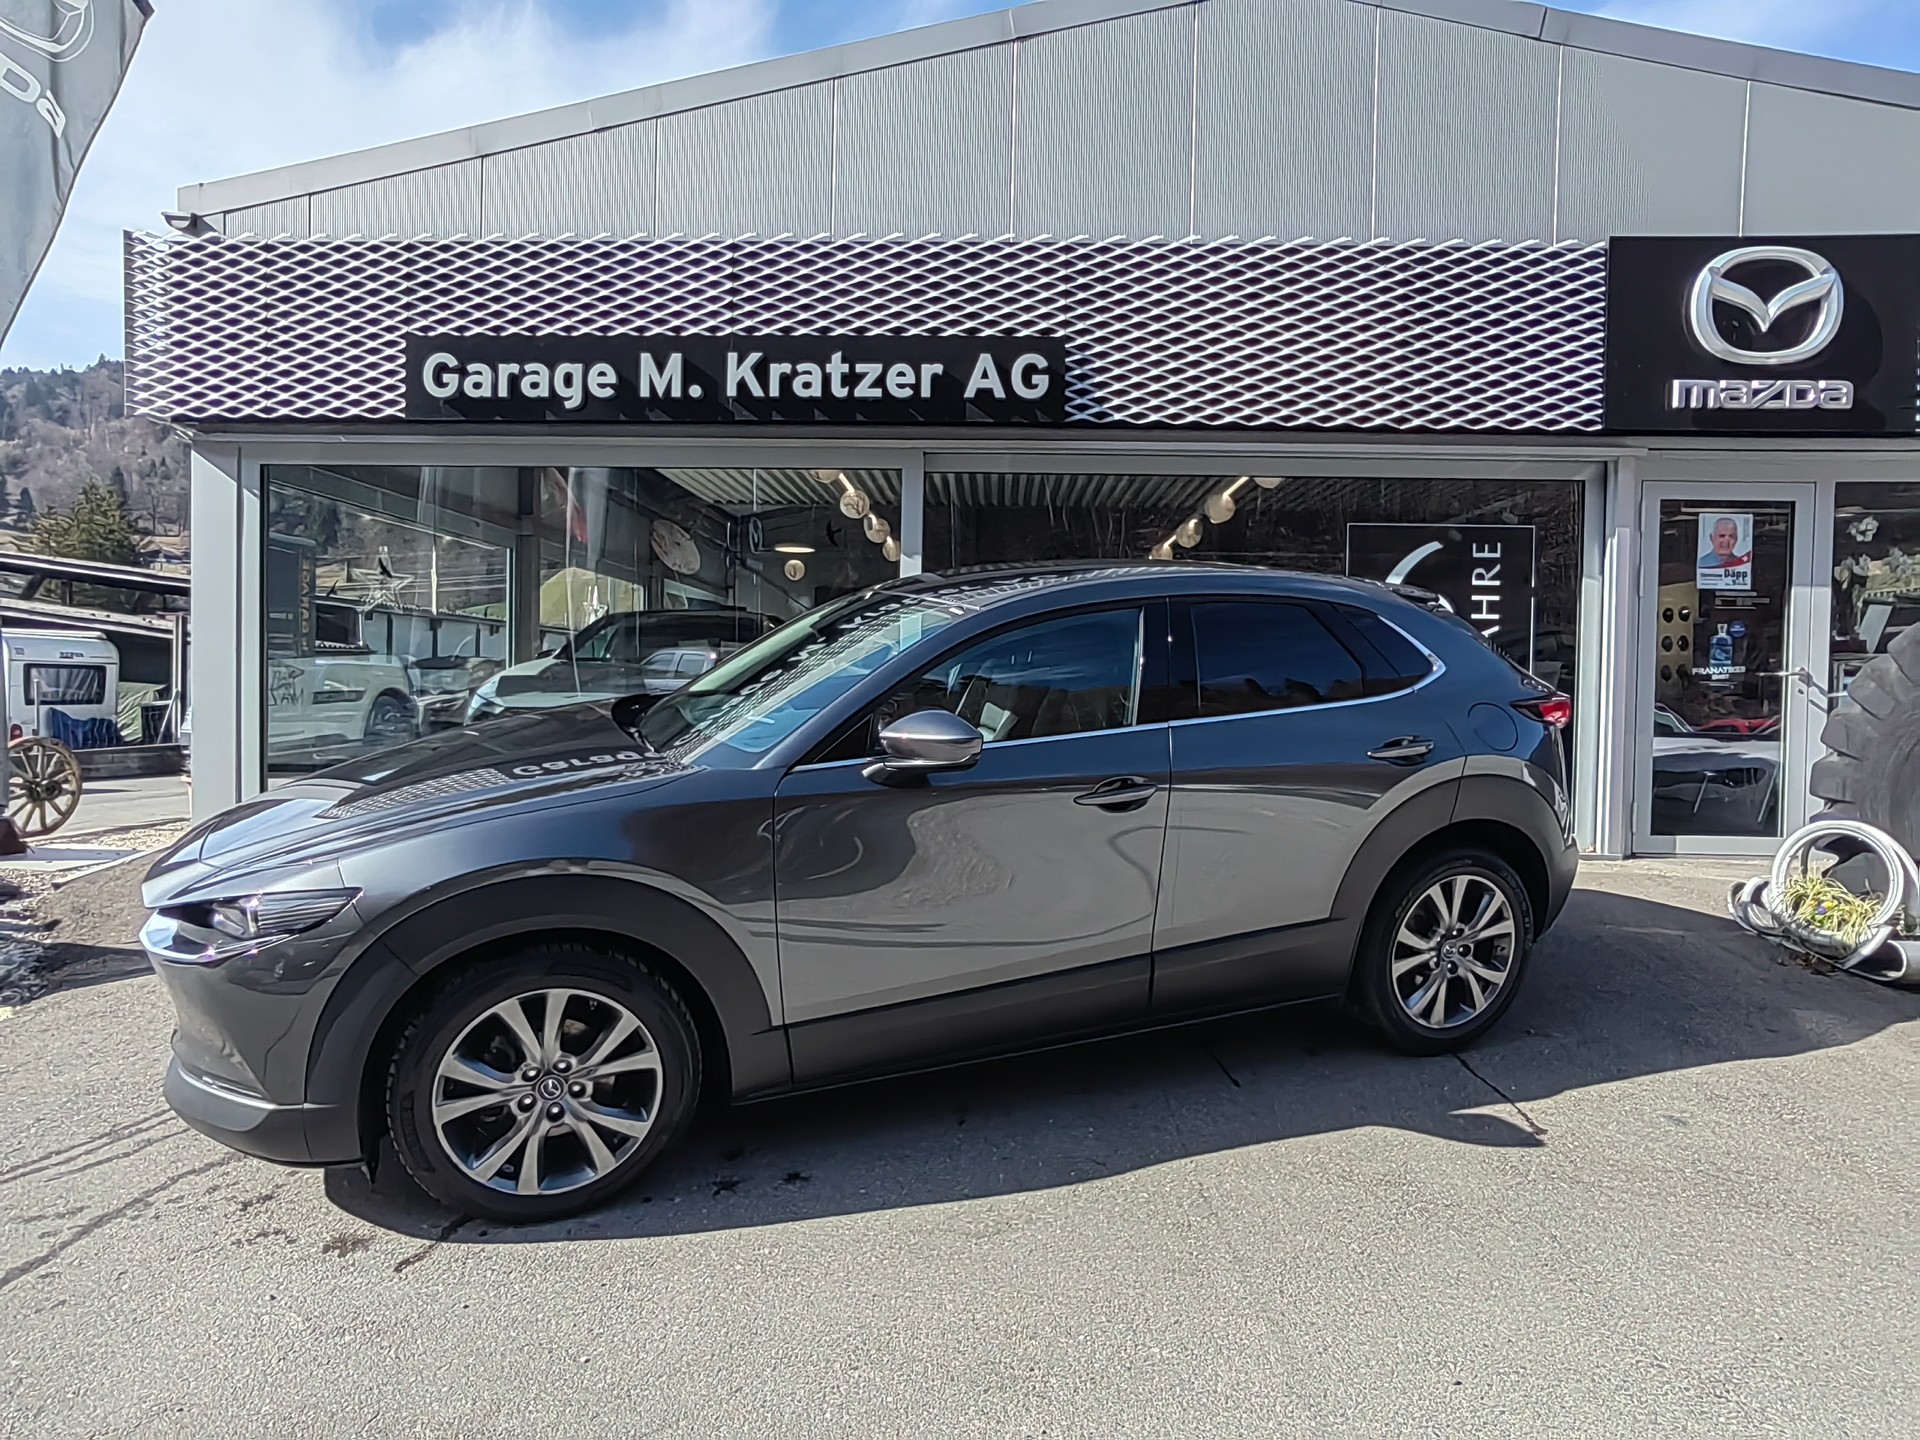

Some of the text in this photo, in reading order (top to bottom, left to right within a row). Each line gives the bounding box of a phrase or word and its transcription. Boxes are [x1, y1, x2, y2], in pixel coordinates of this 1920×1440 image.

[423, 351, 1050, 409] Garage M. Kratzer AG
